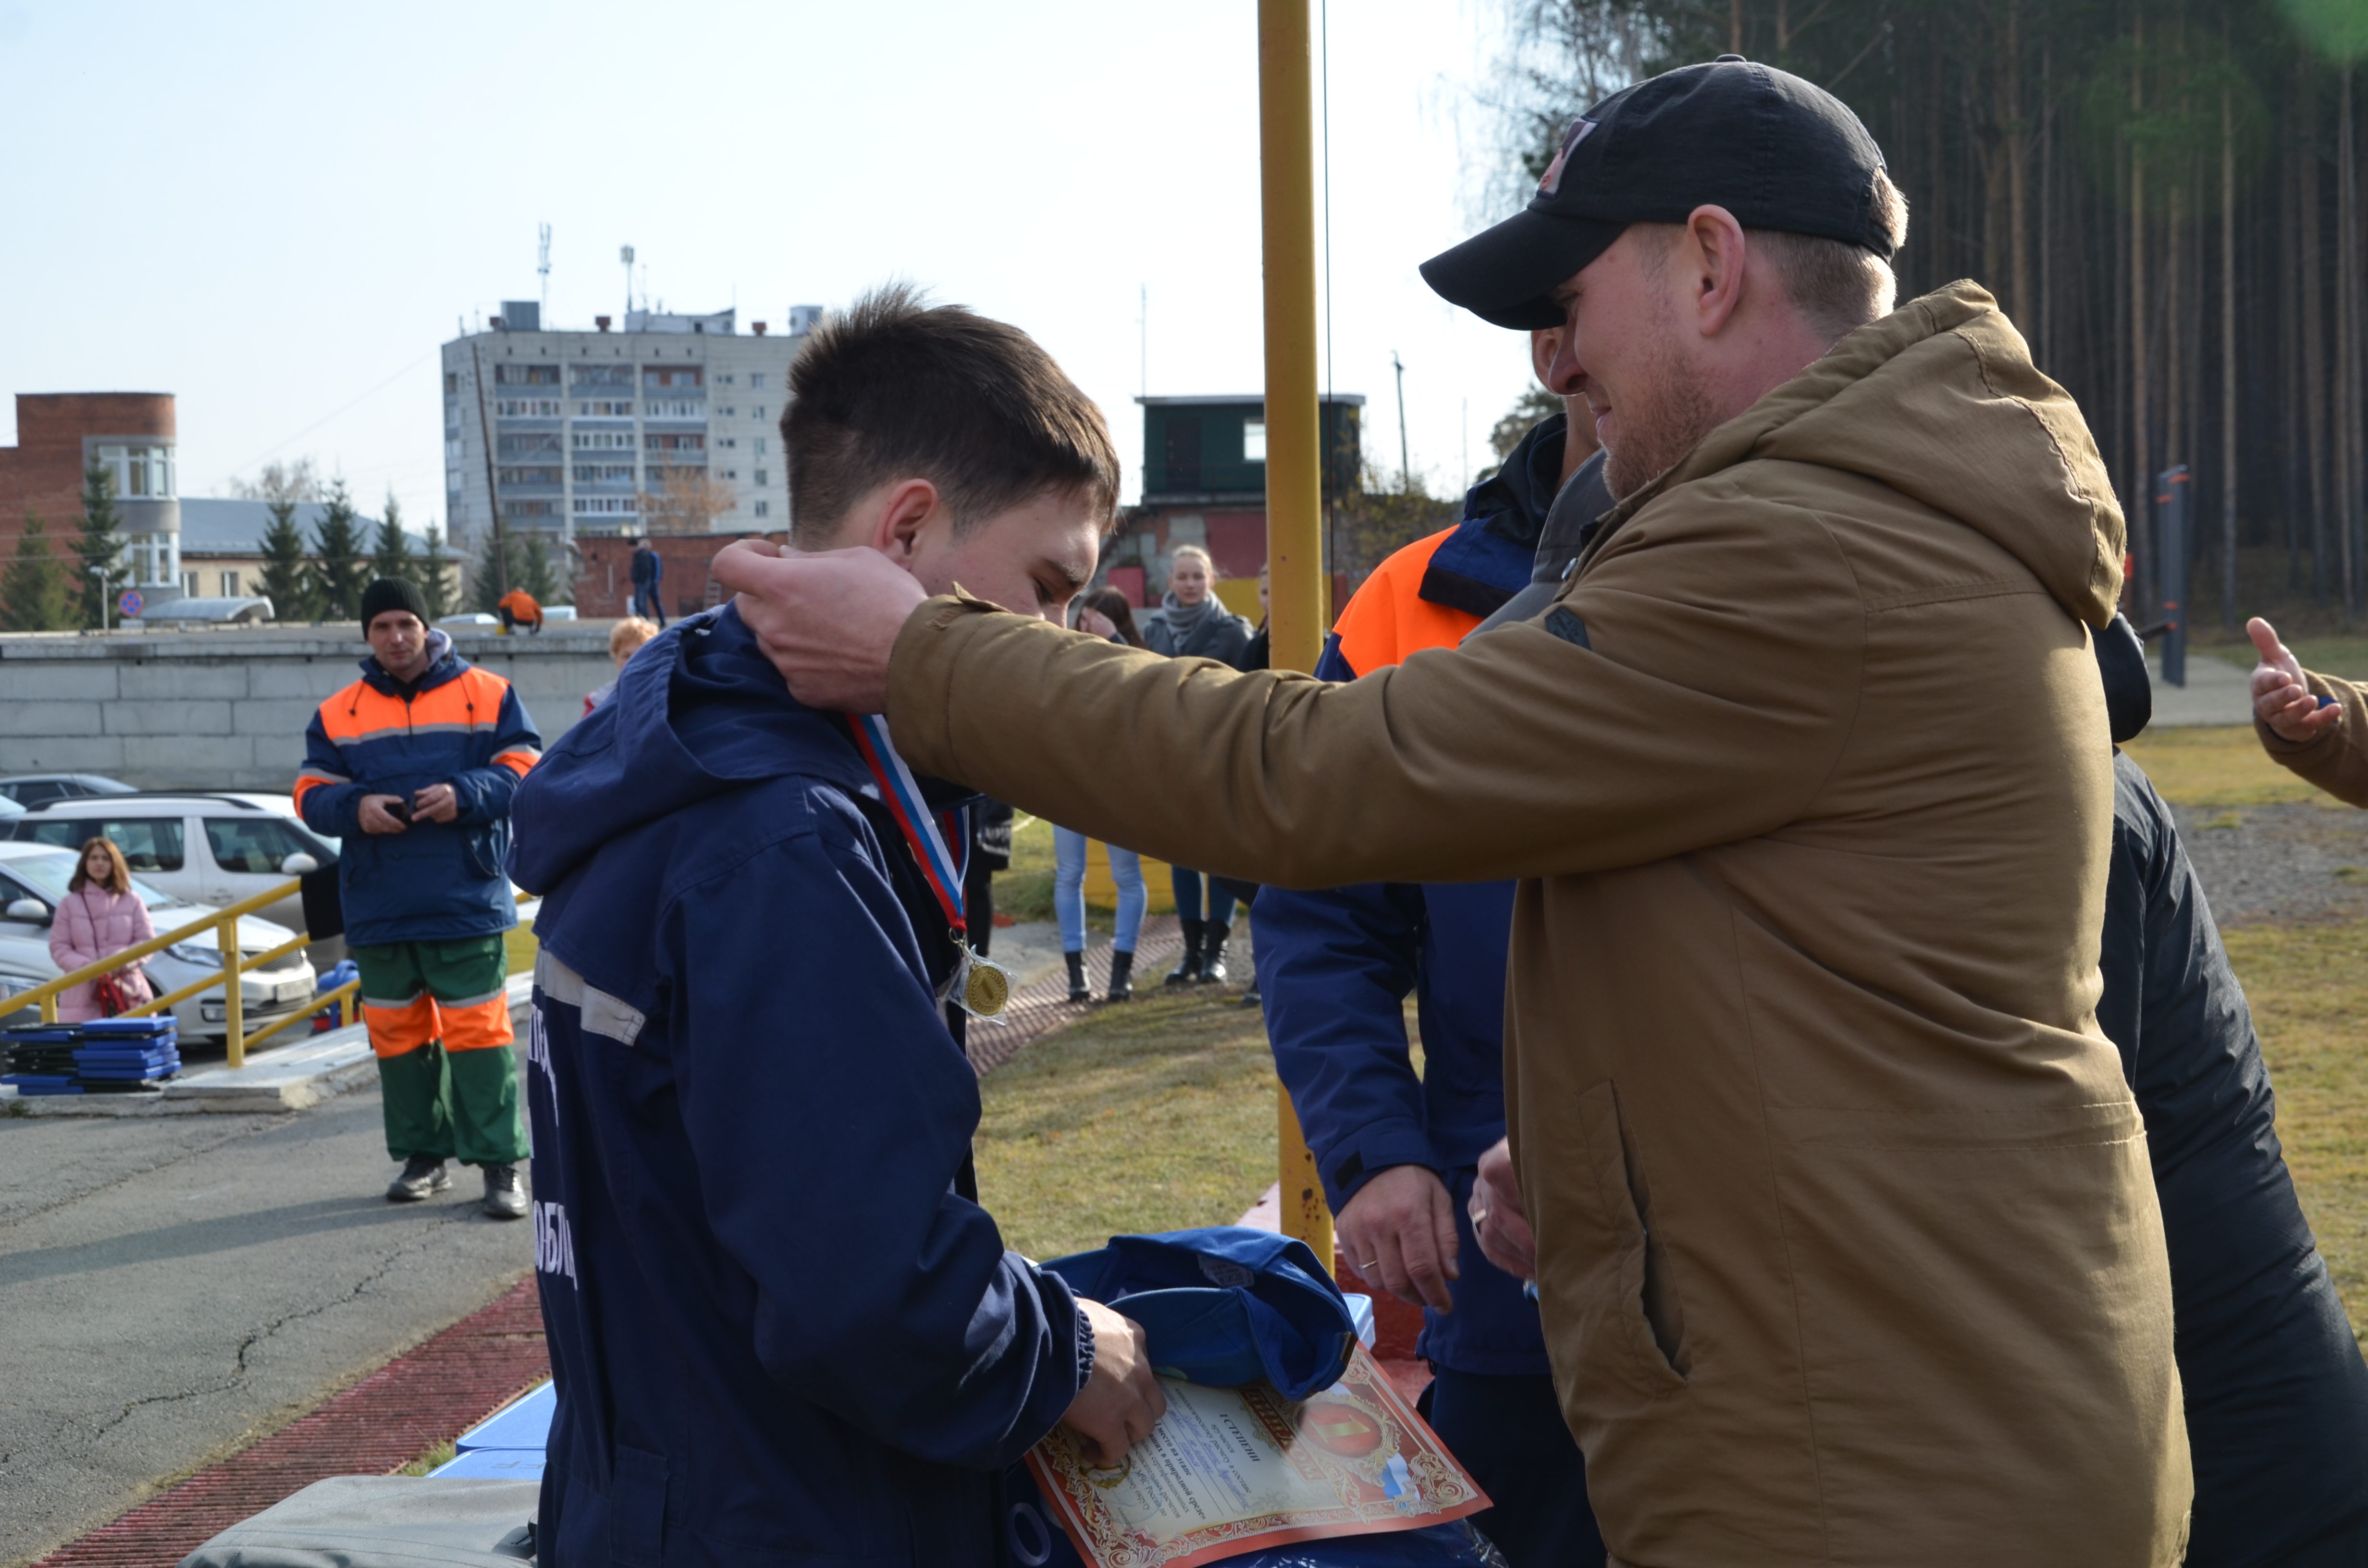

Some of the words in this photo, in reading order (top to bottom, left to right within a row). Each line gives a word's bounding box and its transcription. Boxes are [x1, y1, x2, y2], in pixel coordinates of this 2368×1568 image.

[1155, 1427, 1174, 1447] место
[1169, 1448, 1180, 1457] на
[1175, 1457, 1194, 1476] этапе
[1173, 1387, 1216, 1439] кинологическому
[1209, 1439, 1232, 1463] расчету
[1231, 1469, 1253, 1494] составе
[1209, 1423, 1237, 1454] вручается
[1222, 1418, 1261, 1463] СТЕПЕНИ
[1246, 1390, 1325, 1480] ДИПЛОМ
[1309, 1414, 1370, 1444] 1
[1129, 1446, 1167, 1492] во-спасательных
[1159, 1491, 1183, 1518] расчетов
[1130, 1490, 1152, 1510] округу
[1133, 1470, 1151, 1485] МЧС
[1143, 1486, 1165, 1507] России
[1157, 1508, 1169, 1517] по
[1139, 1439, 1155, 1456] ьных
[1147, 1457, 1195, 1514] сертификационных
[1147, 1433, 1164, 1452] вших
[1160, 1458, 1195, 1496] природной
[1185, 1496, 1209, 1520] среде»
